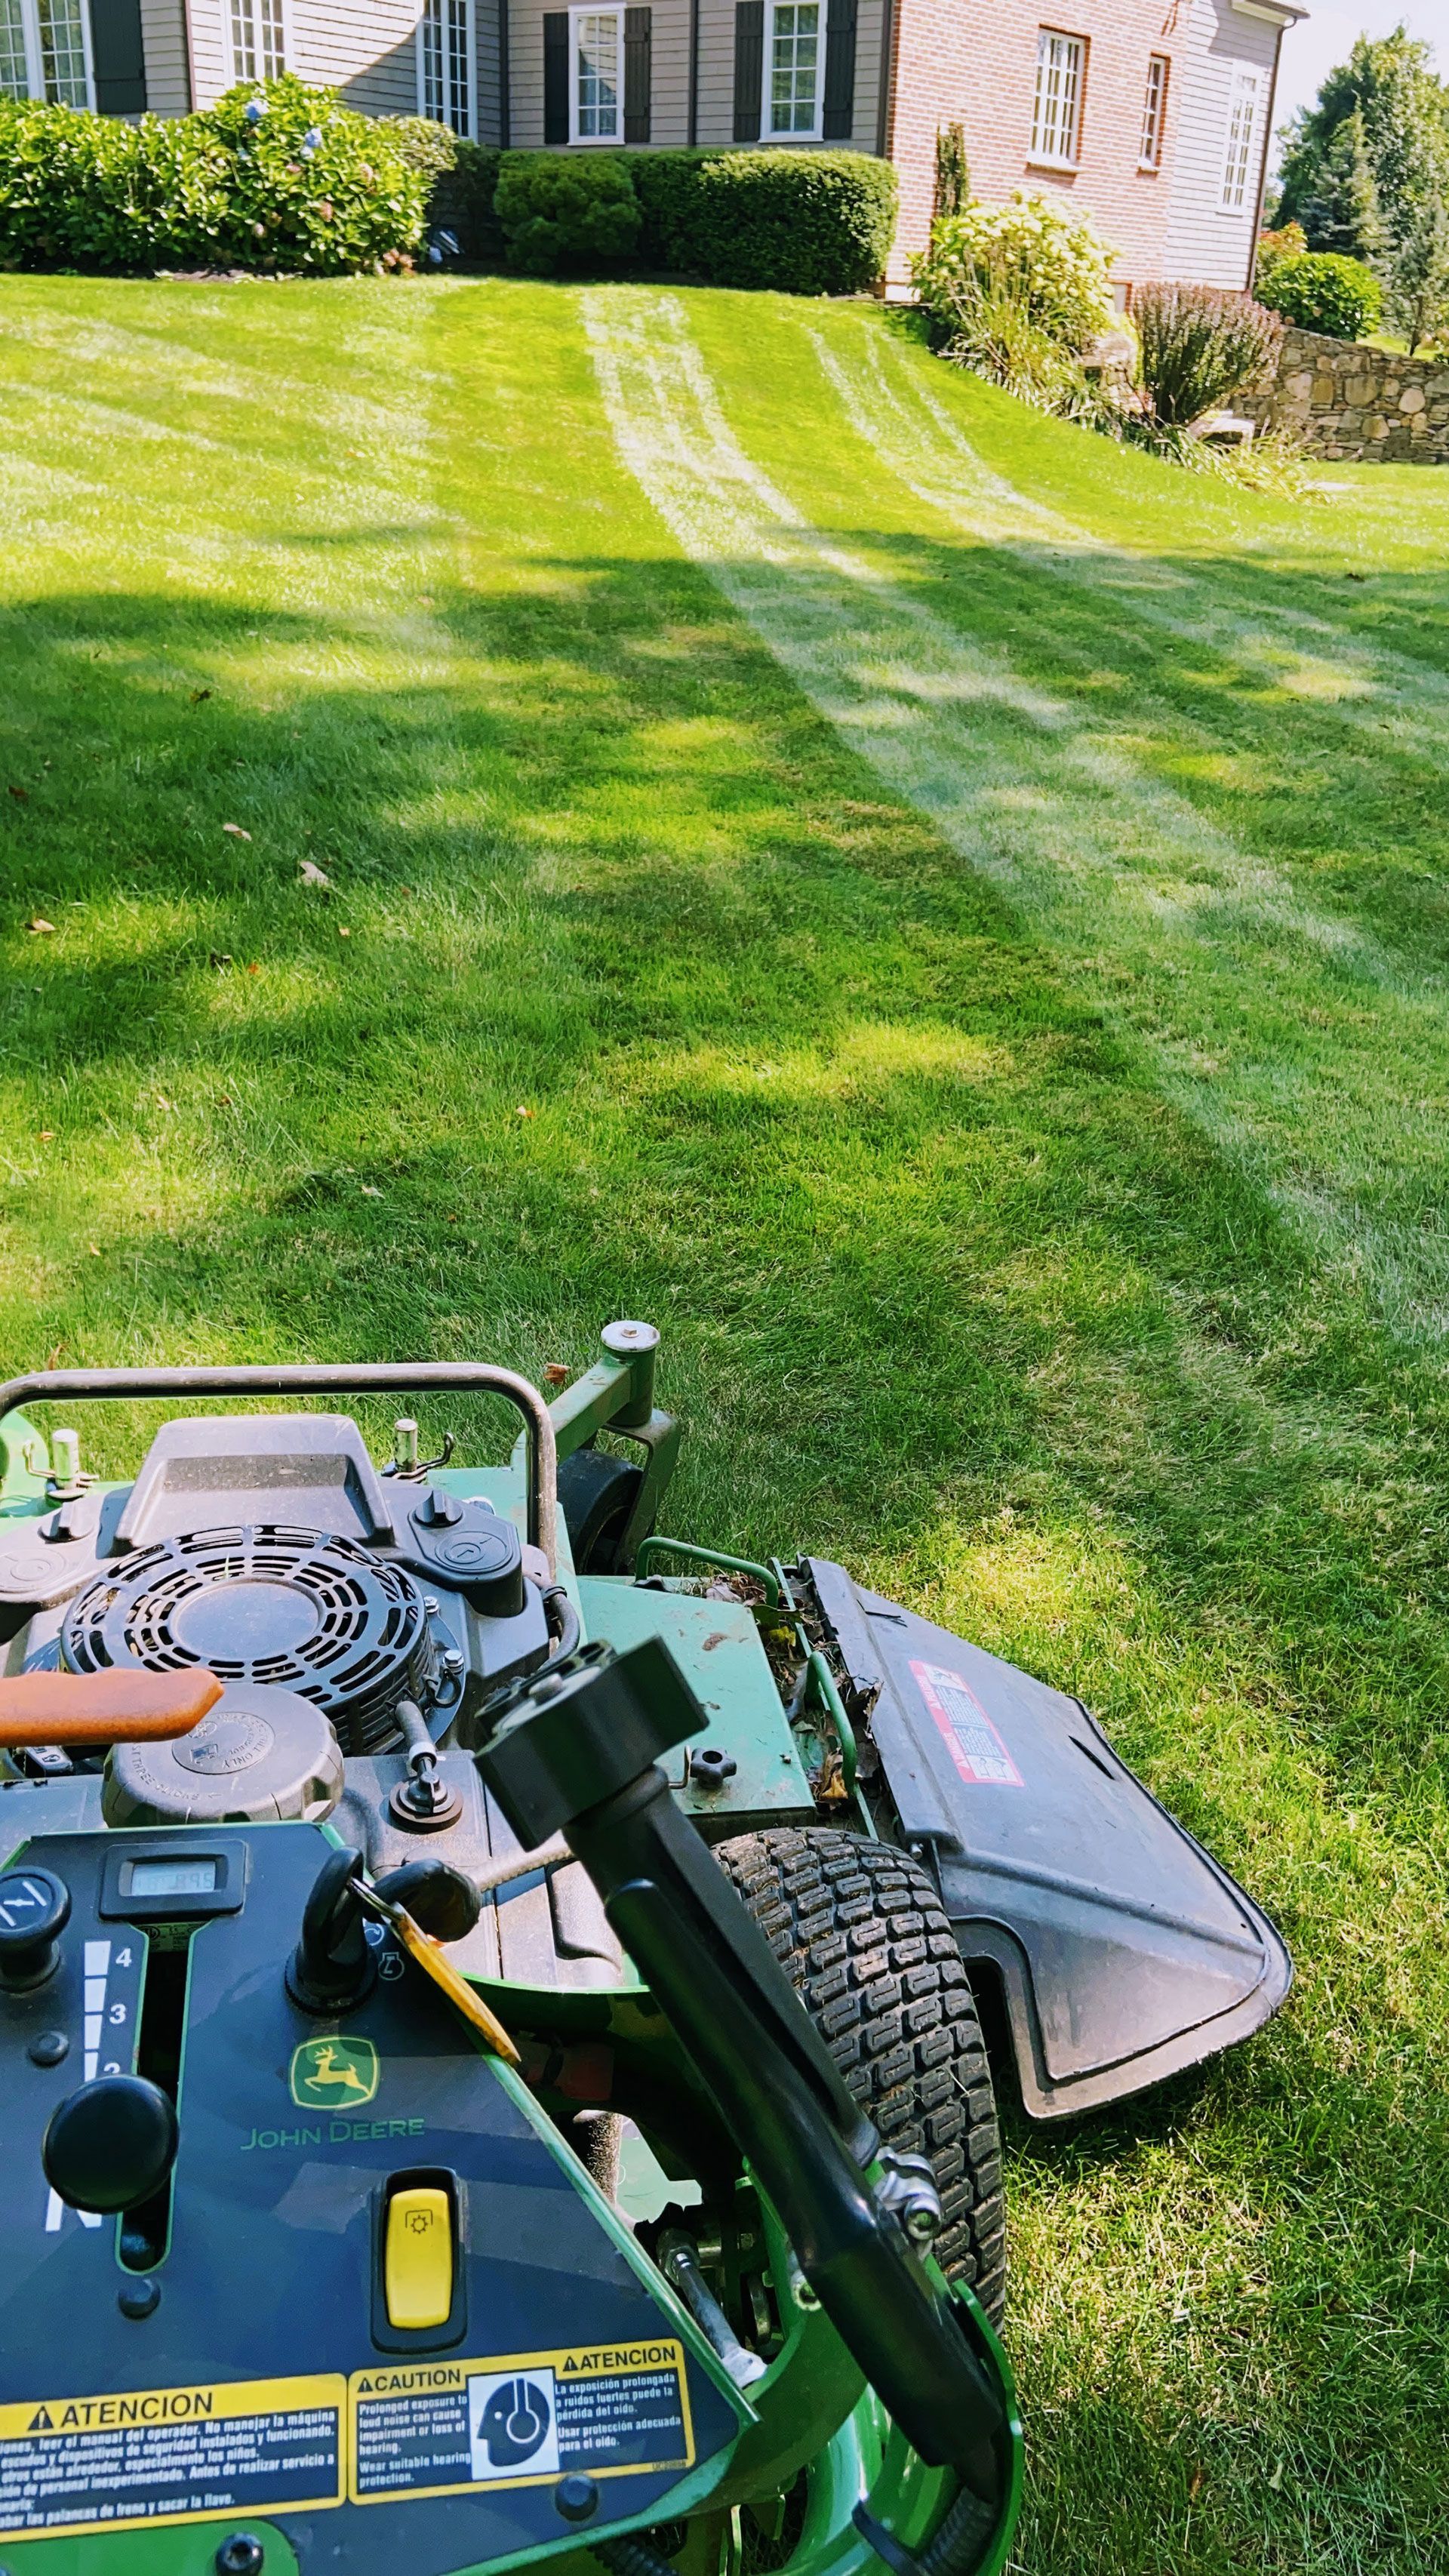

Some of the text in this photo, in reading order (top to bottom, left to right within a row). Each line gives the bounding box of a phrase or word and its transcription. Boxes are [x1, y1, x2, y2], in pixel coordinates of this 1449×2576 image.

[115, 1948, 132, 1968] 4
[109, 2004, 127, 2024] 3
[240, 2119, 425, 2150] JOHN DEERE
[580, 2345, 676, 2370] ATENCION
[375, 2368, 460, 2391] CAUTION
[555, 2373, 675, 2395] La exposición prolongada
[359, 2395, 467, 2415] Prolonged exposure to
[556, 2387, 672, 2408] a ruidos fuertes puede la
[60, 2392, 213, 2428] ATENCION
[359, 2409, 461, 2428] loud noise can cause
[595, 2405, 611, 2416] del
[80, 2430, 123, 2447] manual
[126, 2428, 144, 2442] del
[205, 2421, 220, 2434] No
[224, 2417, 270, 2432] manejar
[273, 2414, 284, 2427] la
[359, 2420, 466, 2442] impairment or loss of
[558, 2427, 580, 2439] Usar
[635, 2416, 681, 2430] adecuada
[126, 2444, 140, 2457] de
[143, 2437, 197, 2458] seguridad
[199, 2433, 255, 2448] instalados
[257, 2433, 264, 2445] y
[359, 2442, 401, 2455] hearing.
[558, 2440, 580, 2453] para
[583, 2438, 592, 2449] el
[125, 2451, 205, 2472] especialmente
[208, 2450, 224, 2462] los
[359, 2452, 471, 2473] Wear suitable hearing
[40, 2476, 88, 2498] personal
[189, 2465, 220, 2479] Antes
[223, 2463, 236, 2476] de
[238, 2459, 280, 2473] realizar
[282, 2454, 325, 2470] servicio
[328, 2454, 334, 2464] a
[359, 2472, 414, 2489] protection.
[47, 2507, 97, 2526] palancas
[149, 2501, 155, 2516] y
[158, 2498, 189, 2513] sacar
[191, 2494, 202, 2508] la
